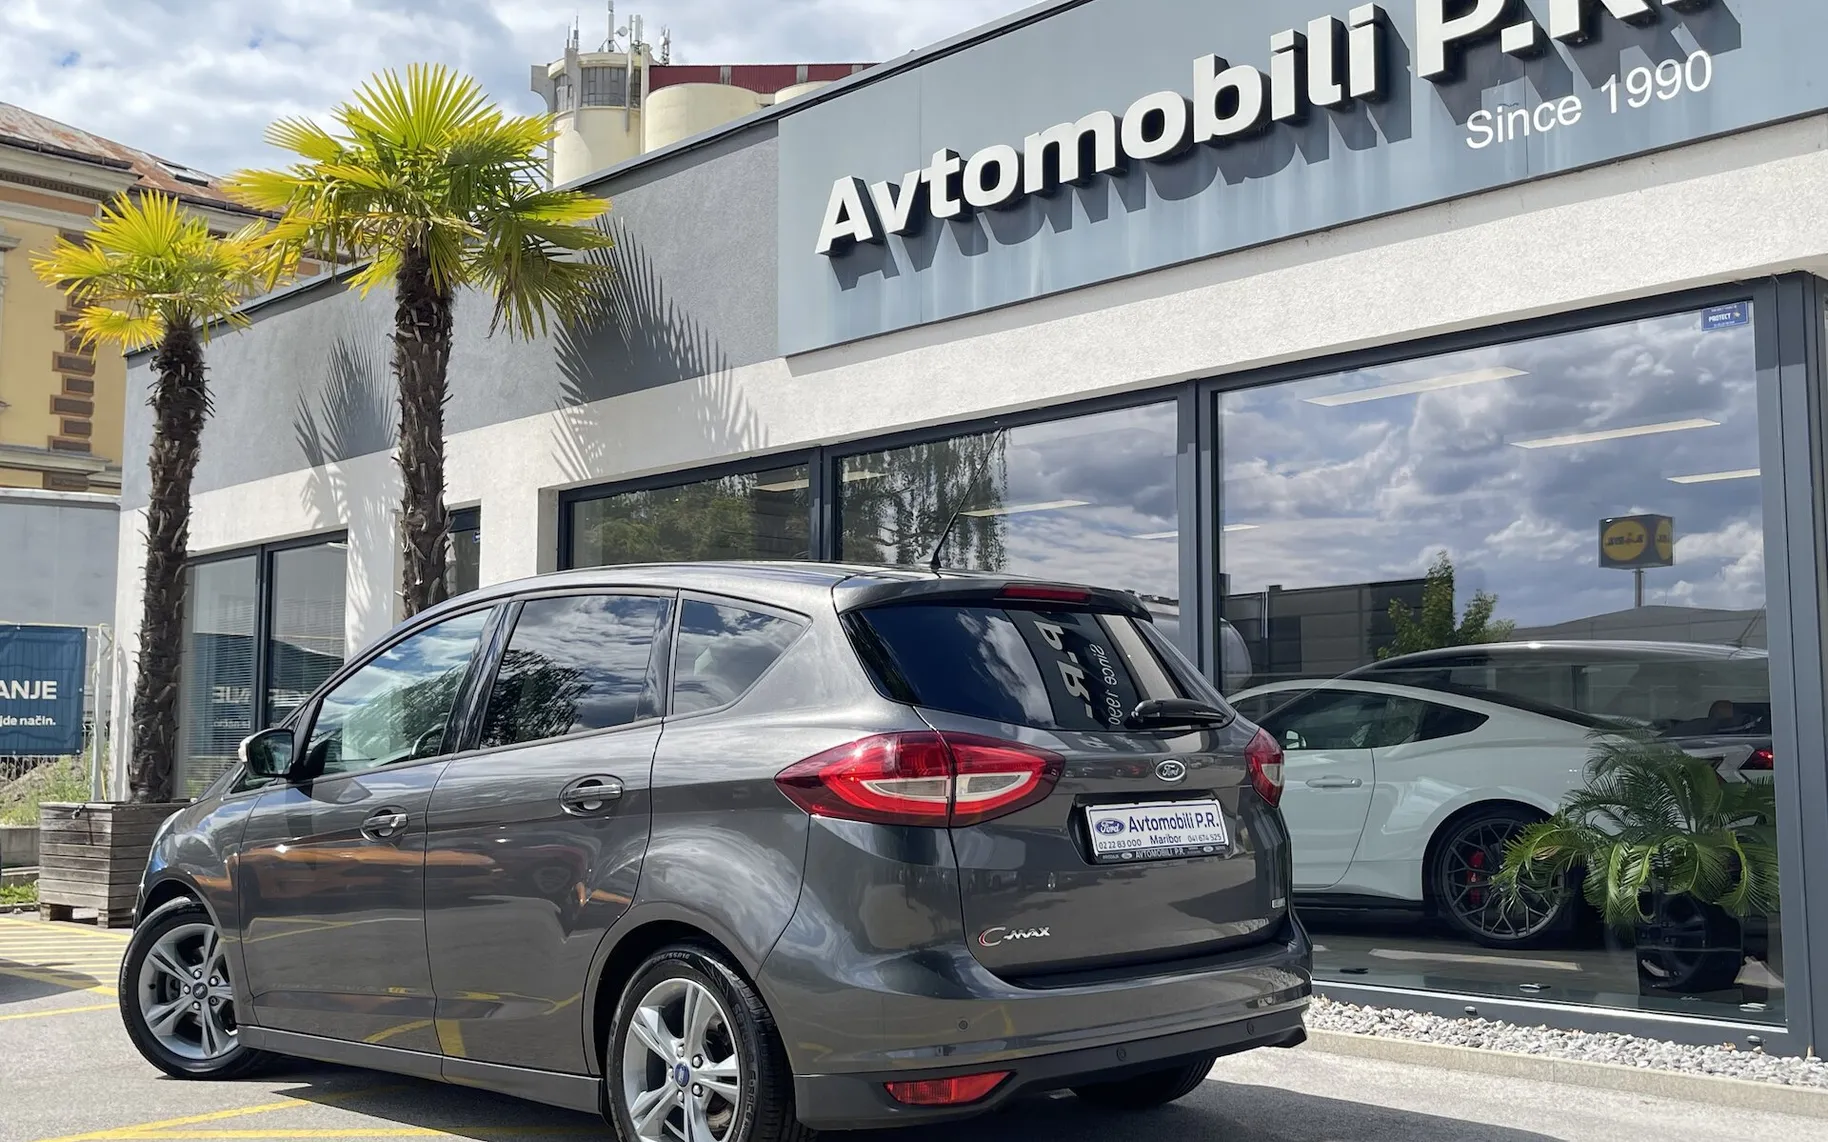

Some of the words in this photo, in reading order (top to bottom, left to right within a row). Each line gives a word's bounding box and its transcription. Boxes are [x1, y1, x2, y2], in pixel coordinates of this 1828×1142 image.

[1465, 95, 1582, 149] Since
[1601, 50, 1712, 114] 1990
[814, 2, 1383, 256] Avtomobili
[1416, 0, 1690, 78] P.
[19, 715, 57, 726] način.
[1099, 820, 1120, 834] Ford
[1129, 812, 1194, 833] Avtomobili
[1195, 812, 1219, 828] P.R.
[1149, 834, 1181, 845] Maribor
